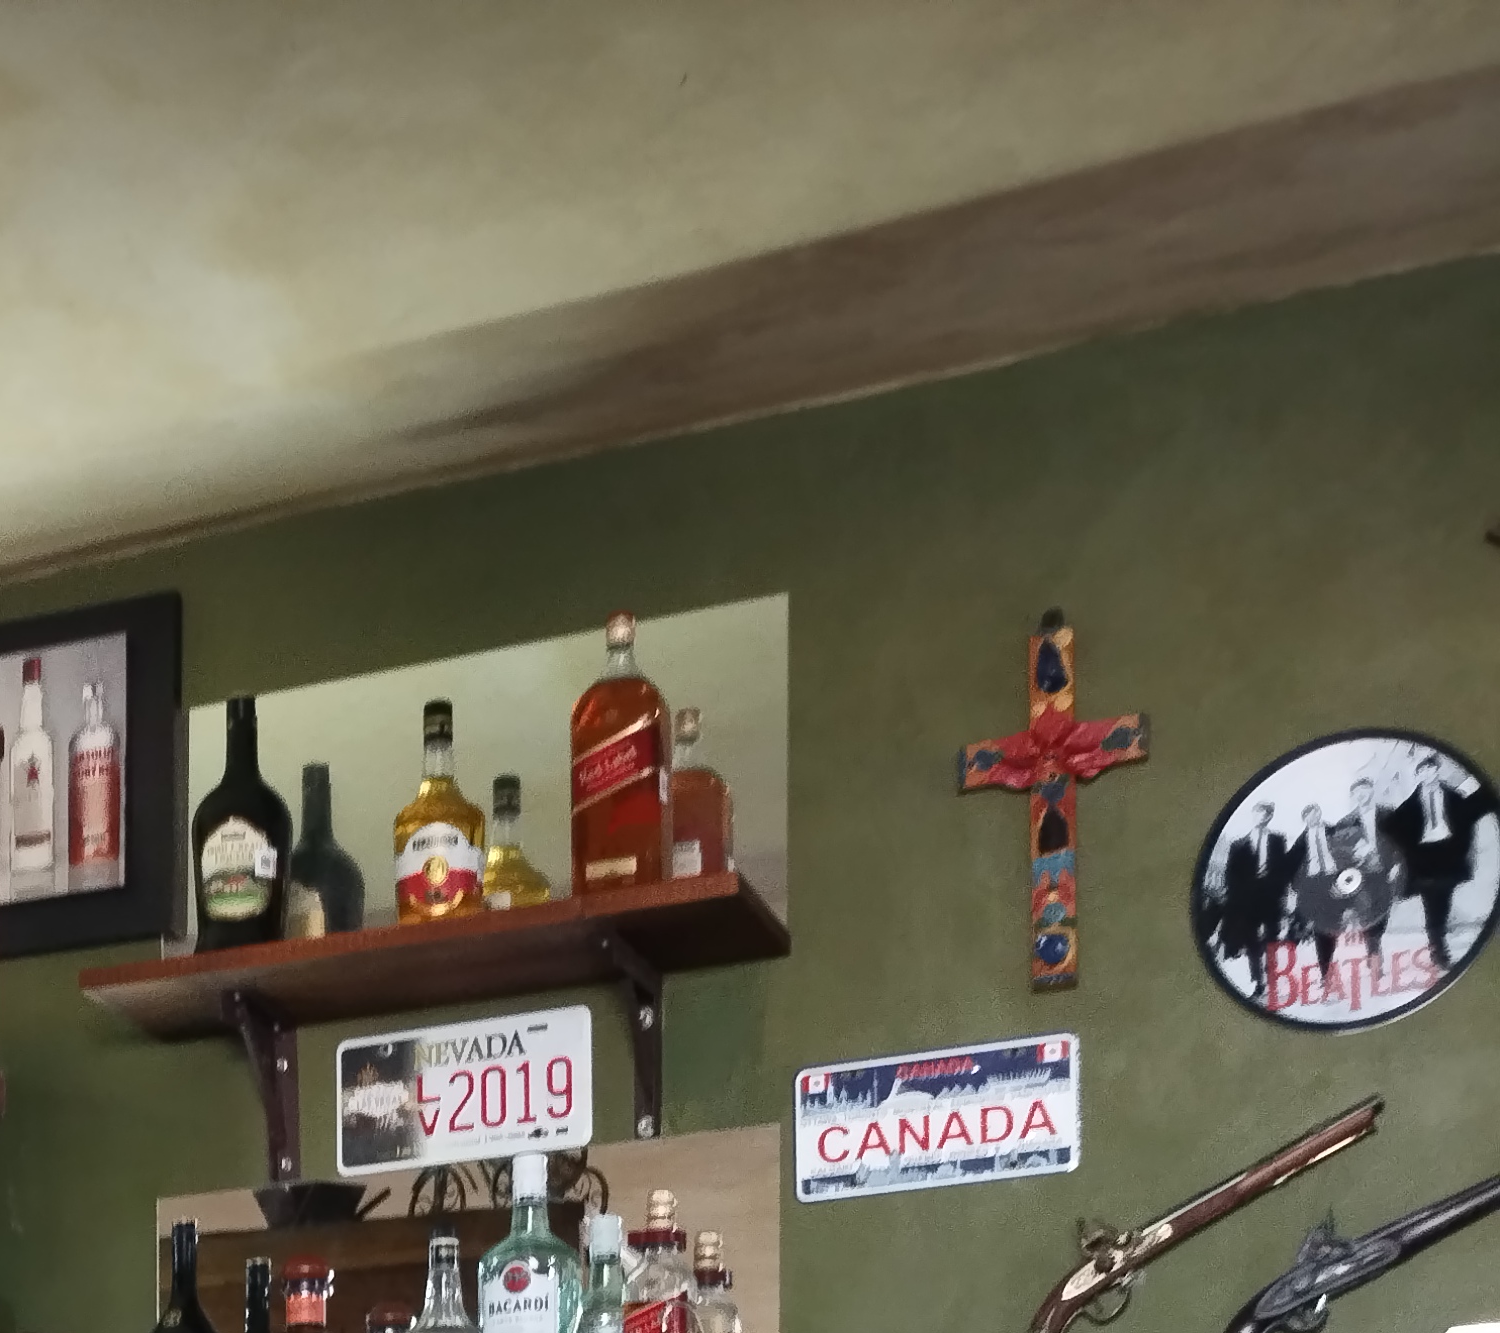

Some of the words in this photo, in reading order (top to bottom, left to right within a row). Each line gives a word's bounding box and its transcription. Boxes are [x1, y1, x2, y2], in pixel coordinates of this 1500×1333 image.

[1267, 940, 1440, 1012] BEATLES
[414, 1029, 528, 1069] NEVADA
[817, 1098, 1058, 1163] CANADA
